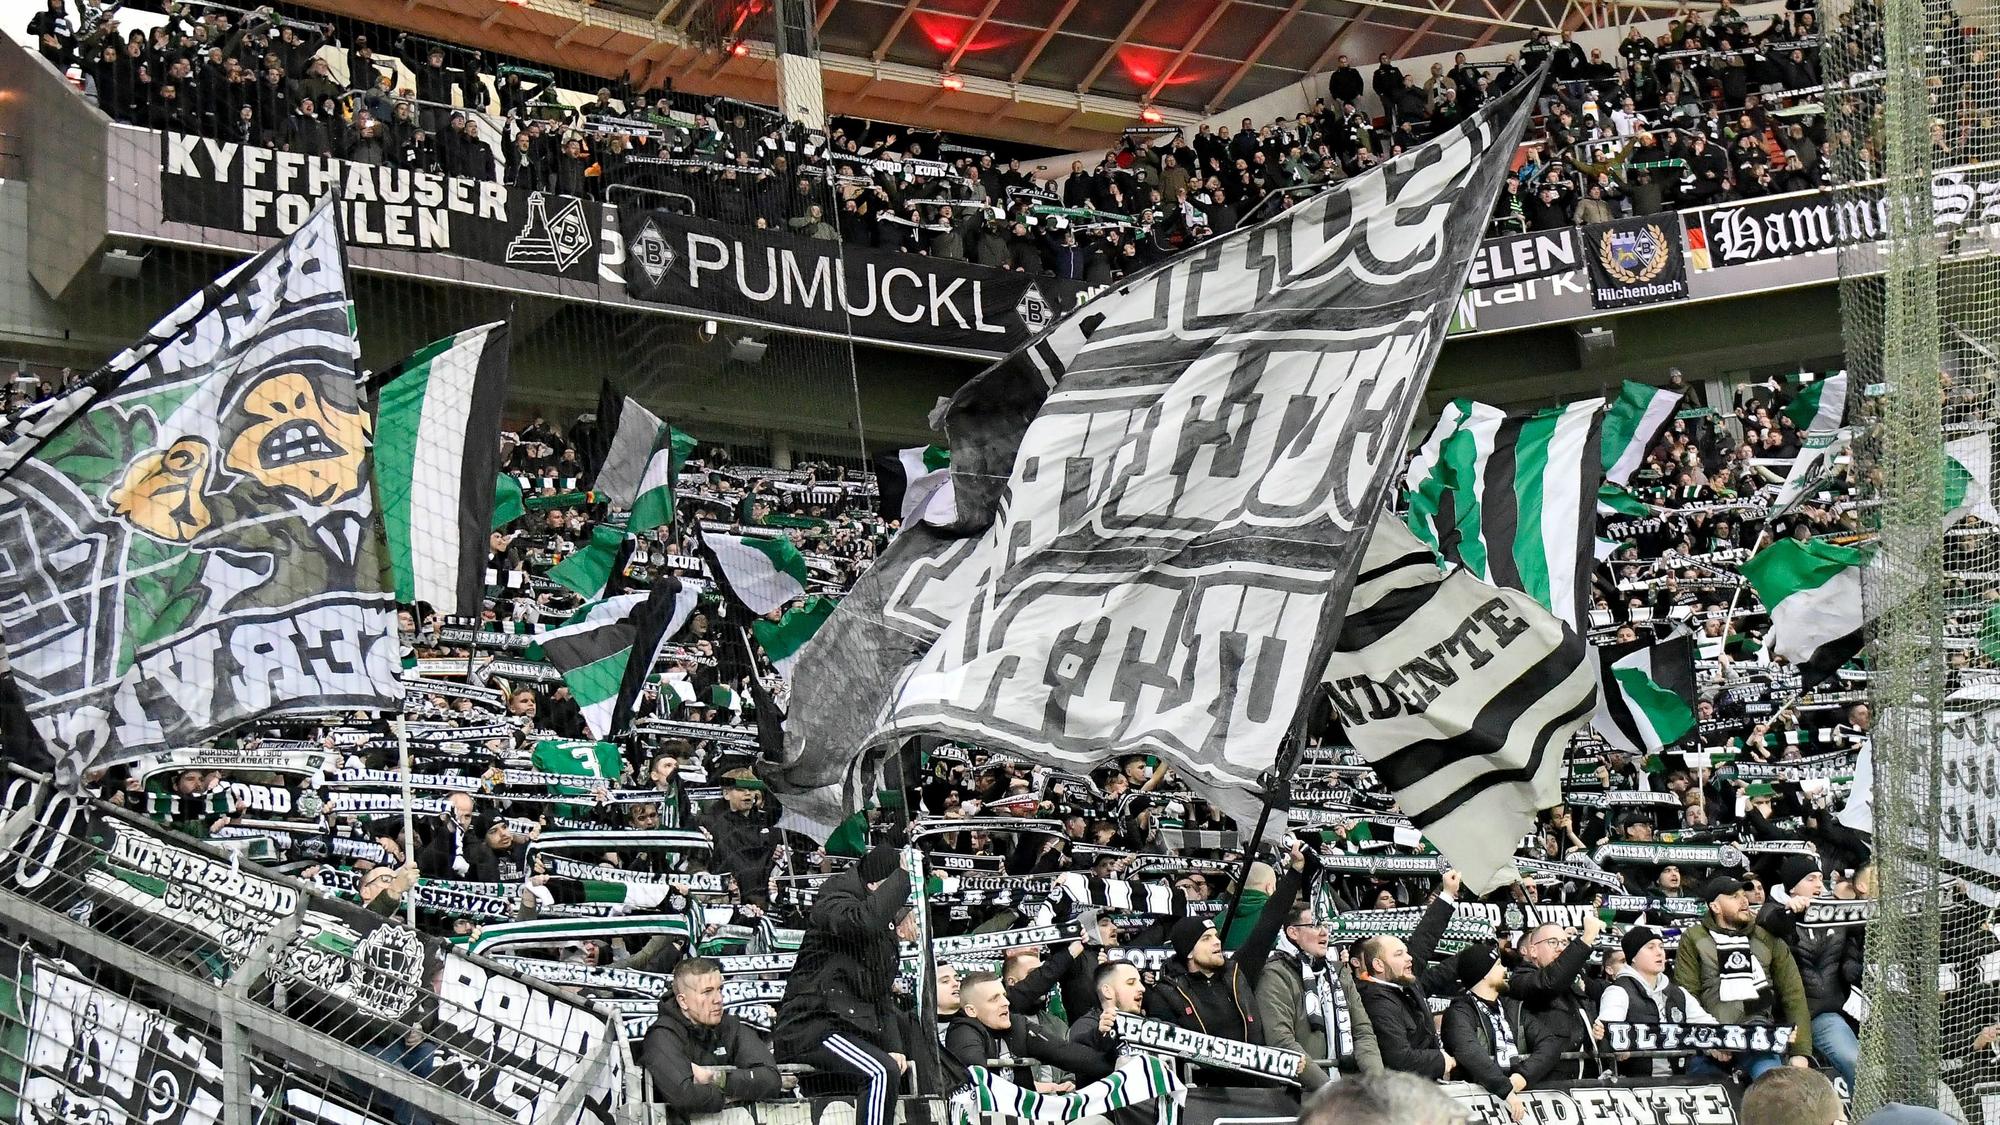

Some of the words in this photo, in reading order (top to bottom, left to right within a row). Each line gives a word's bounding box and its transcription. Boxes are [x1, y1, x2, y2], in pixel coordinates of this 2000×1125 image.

[242, 188, 451, 249] FOLEN
[687, 231, 1006, 334] PUMUCKL
[1596, 279, 1683, 303] Hilchenbach
[108, 832, 299, 916] AUFSTREBEND
[944, 857, 975, 869] 1900
